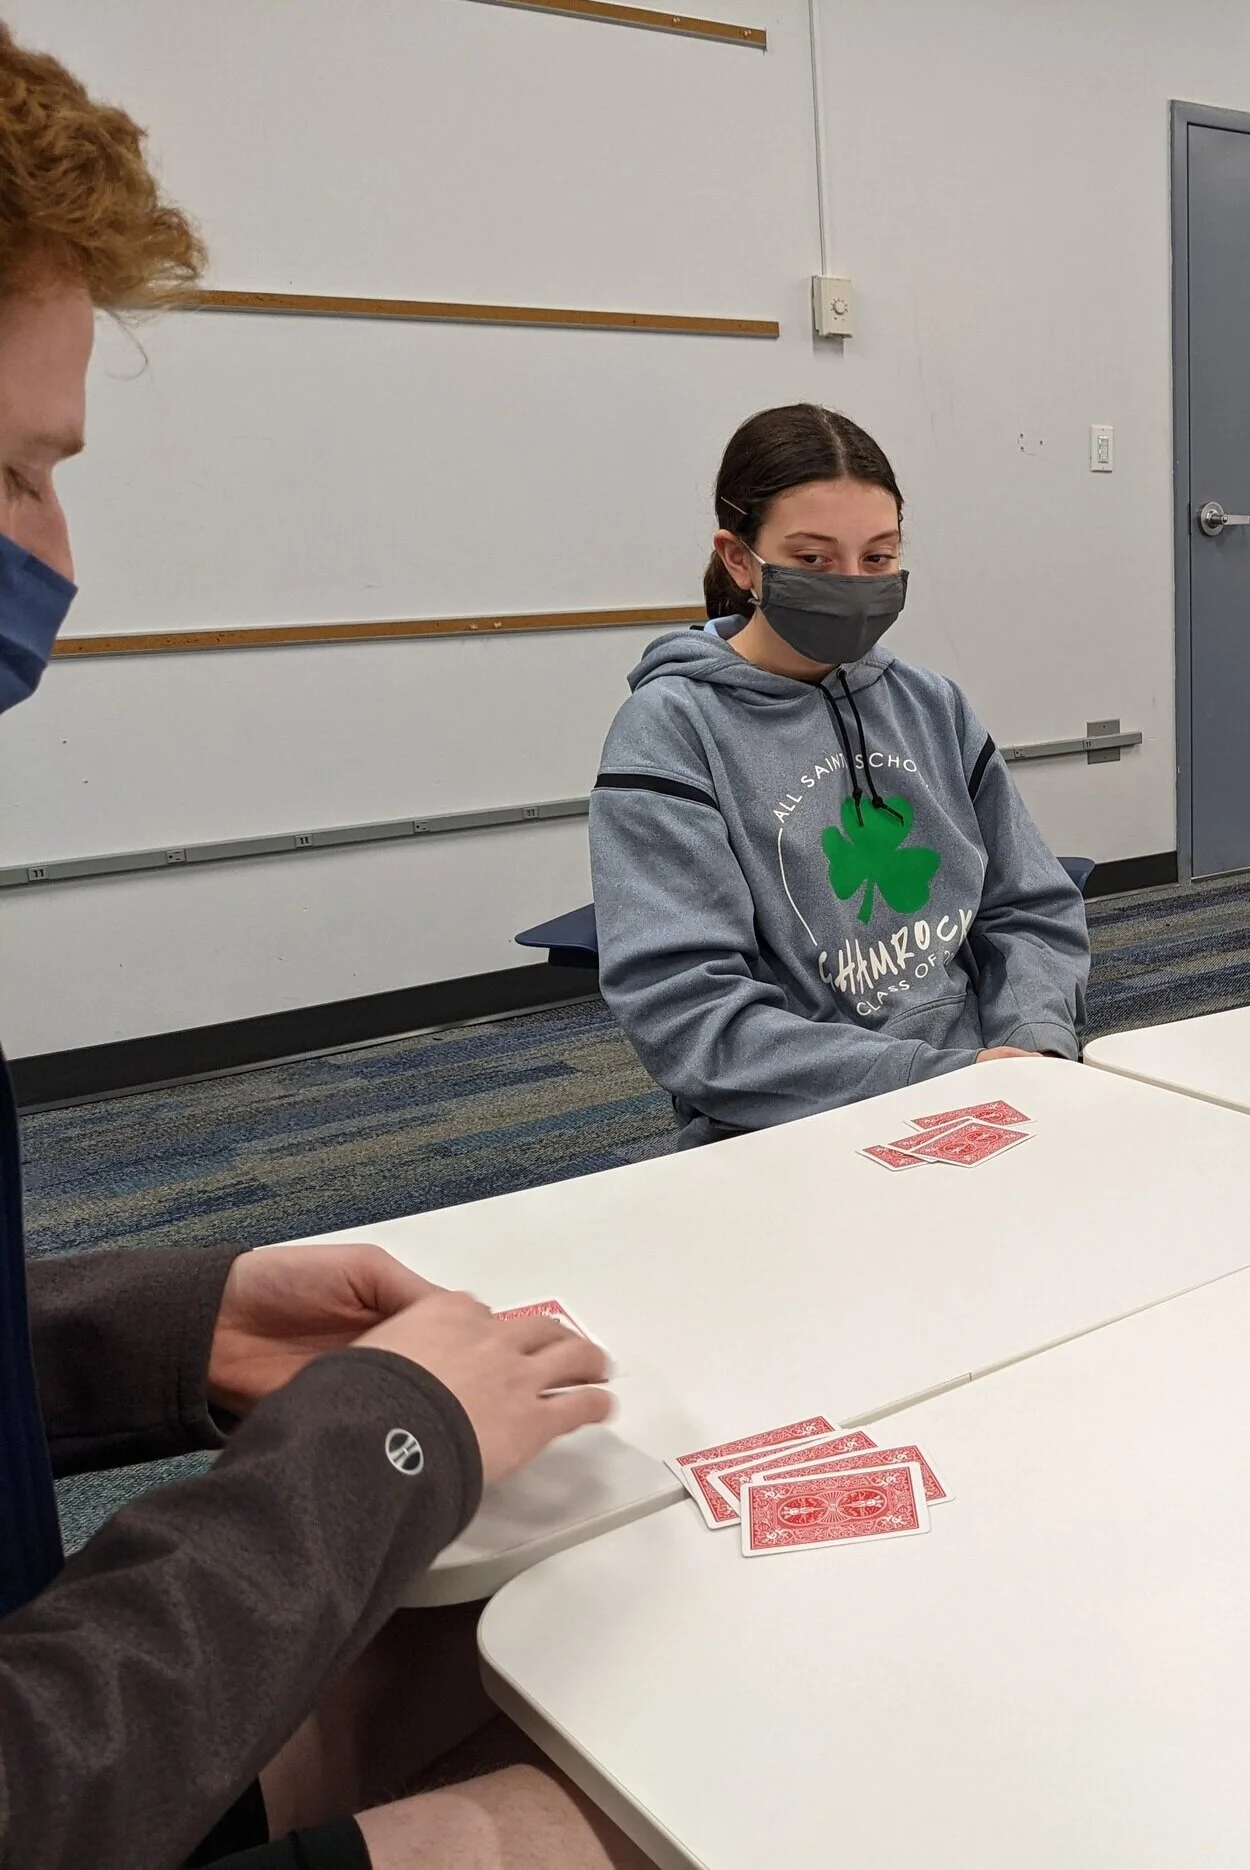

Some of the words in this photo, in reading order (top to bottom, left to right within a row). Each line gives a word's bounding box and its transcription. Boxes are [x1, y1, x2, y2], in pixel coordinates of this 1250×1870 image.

[773, 793, 803, 824] ALL
[801, 753, 848, 788] SAINT
[855, 752, 918, 773] SCHO
[856, 979, 910, 1016] CLASS
[914, 953, 937, 978] OF
